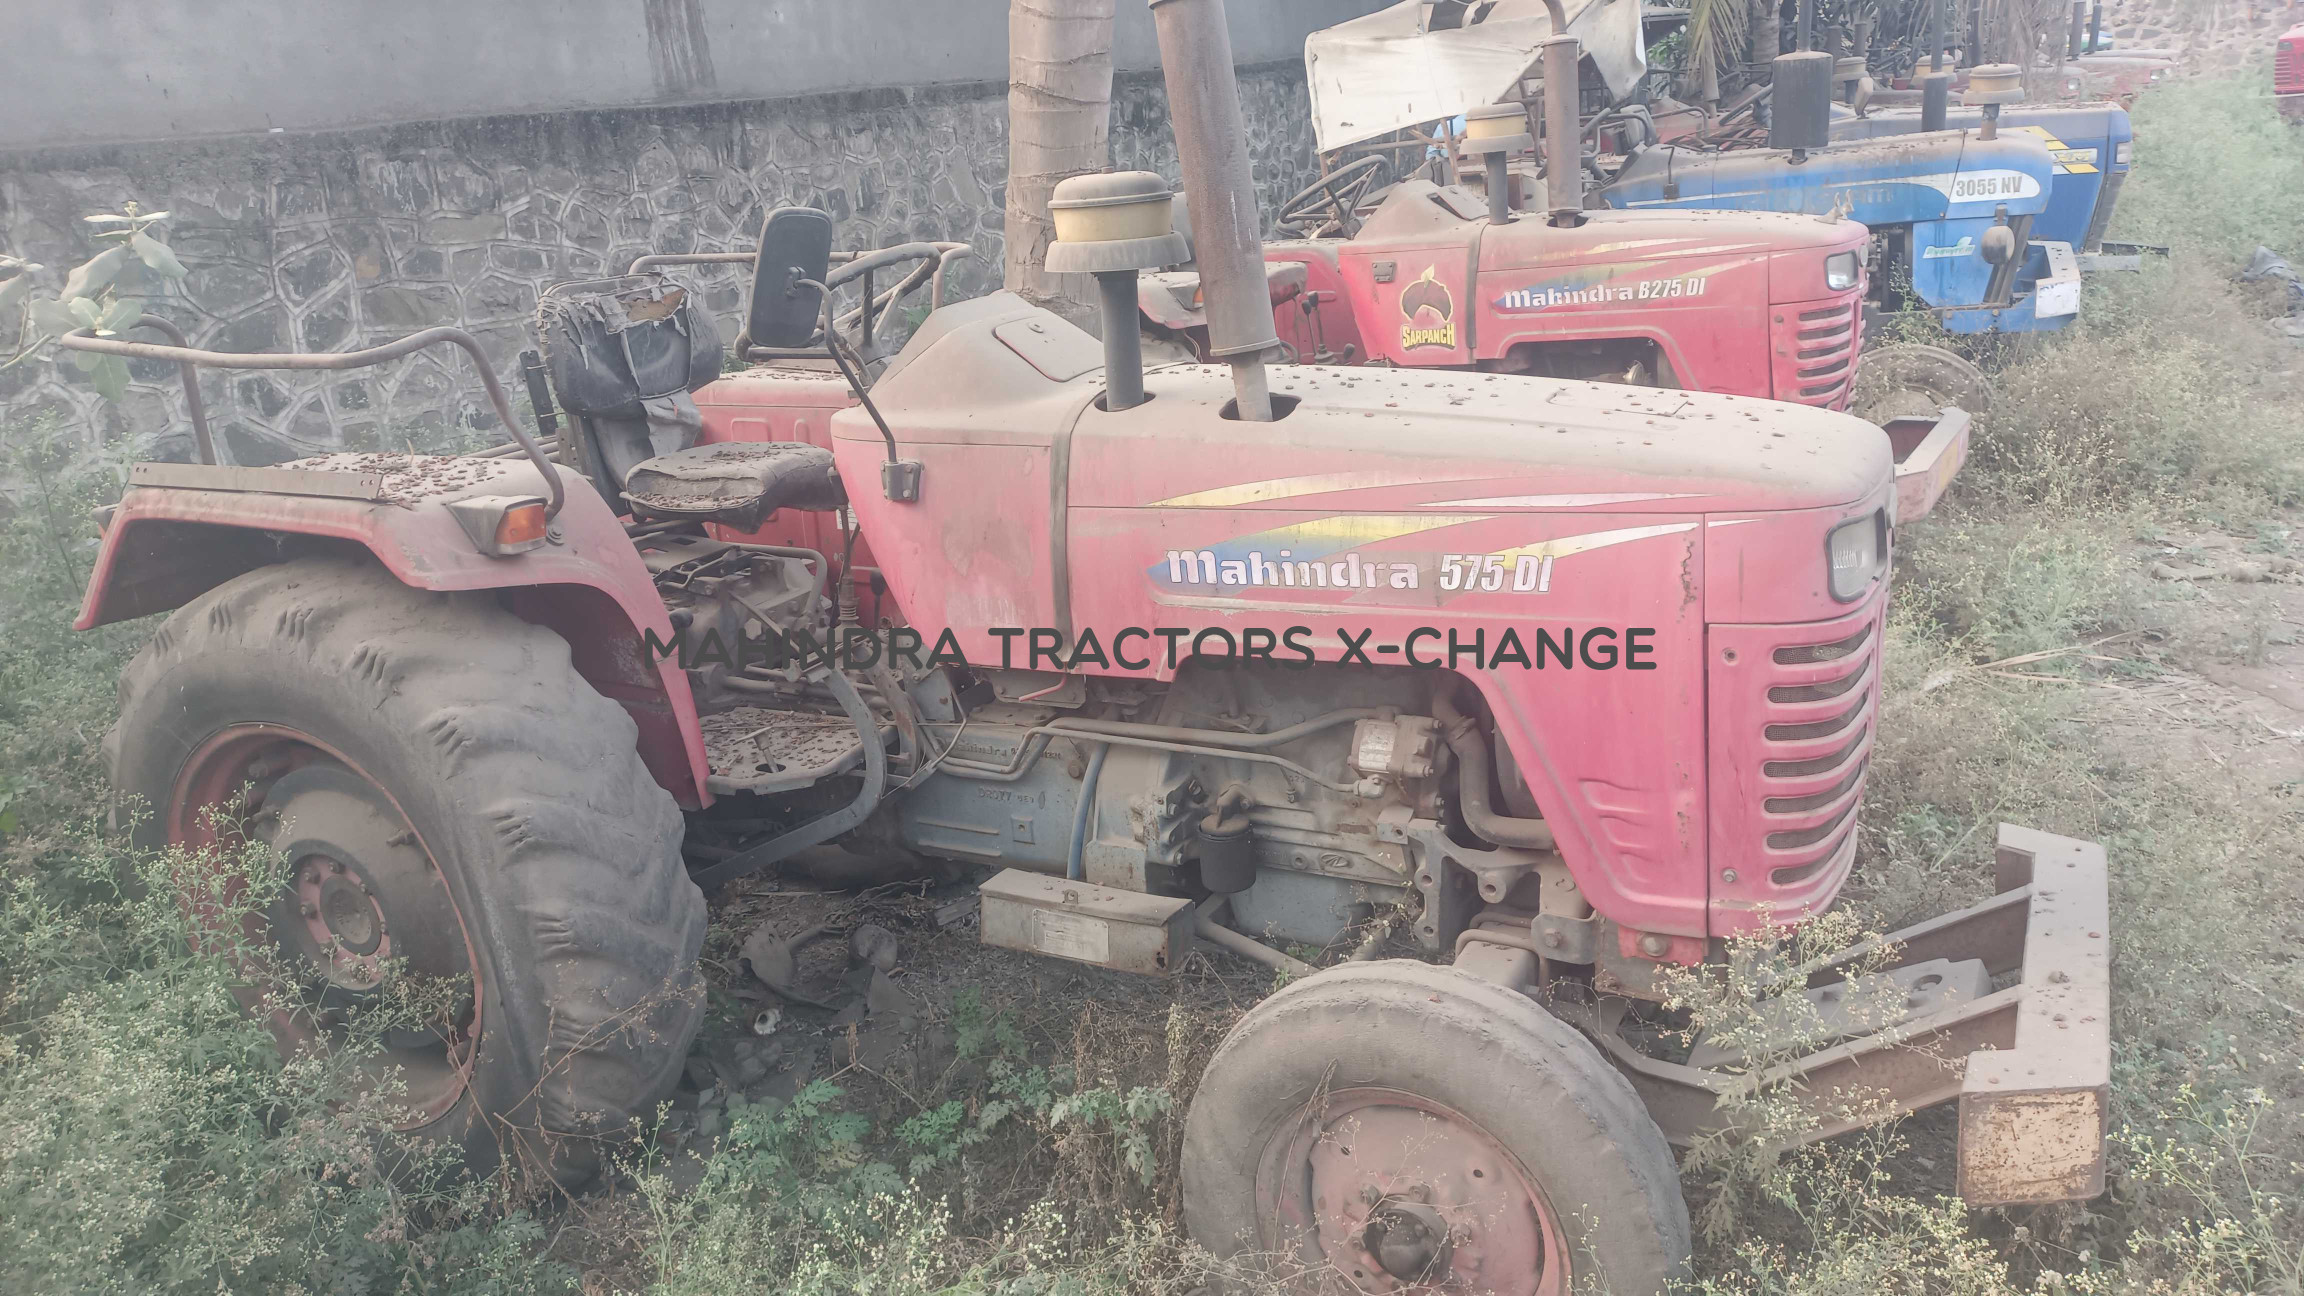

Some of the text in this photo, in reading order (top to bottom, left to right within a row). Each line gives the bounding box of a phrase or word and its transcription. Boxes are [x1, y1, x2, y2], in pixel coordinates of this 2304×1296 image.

[1956, 176, 2023, 196] 3055 NV
[1505, 277, 1705, 308] Mahindra B275 DI
[1402, 323, 1455, 347] SARPANCH
[1166, 549, 1553, 593] Mahindra 575 DI
